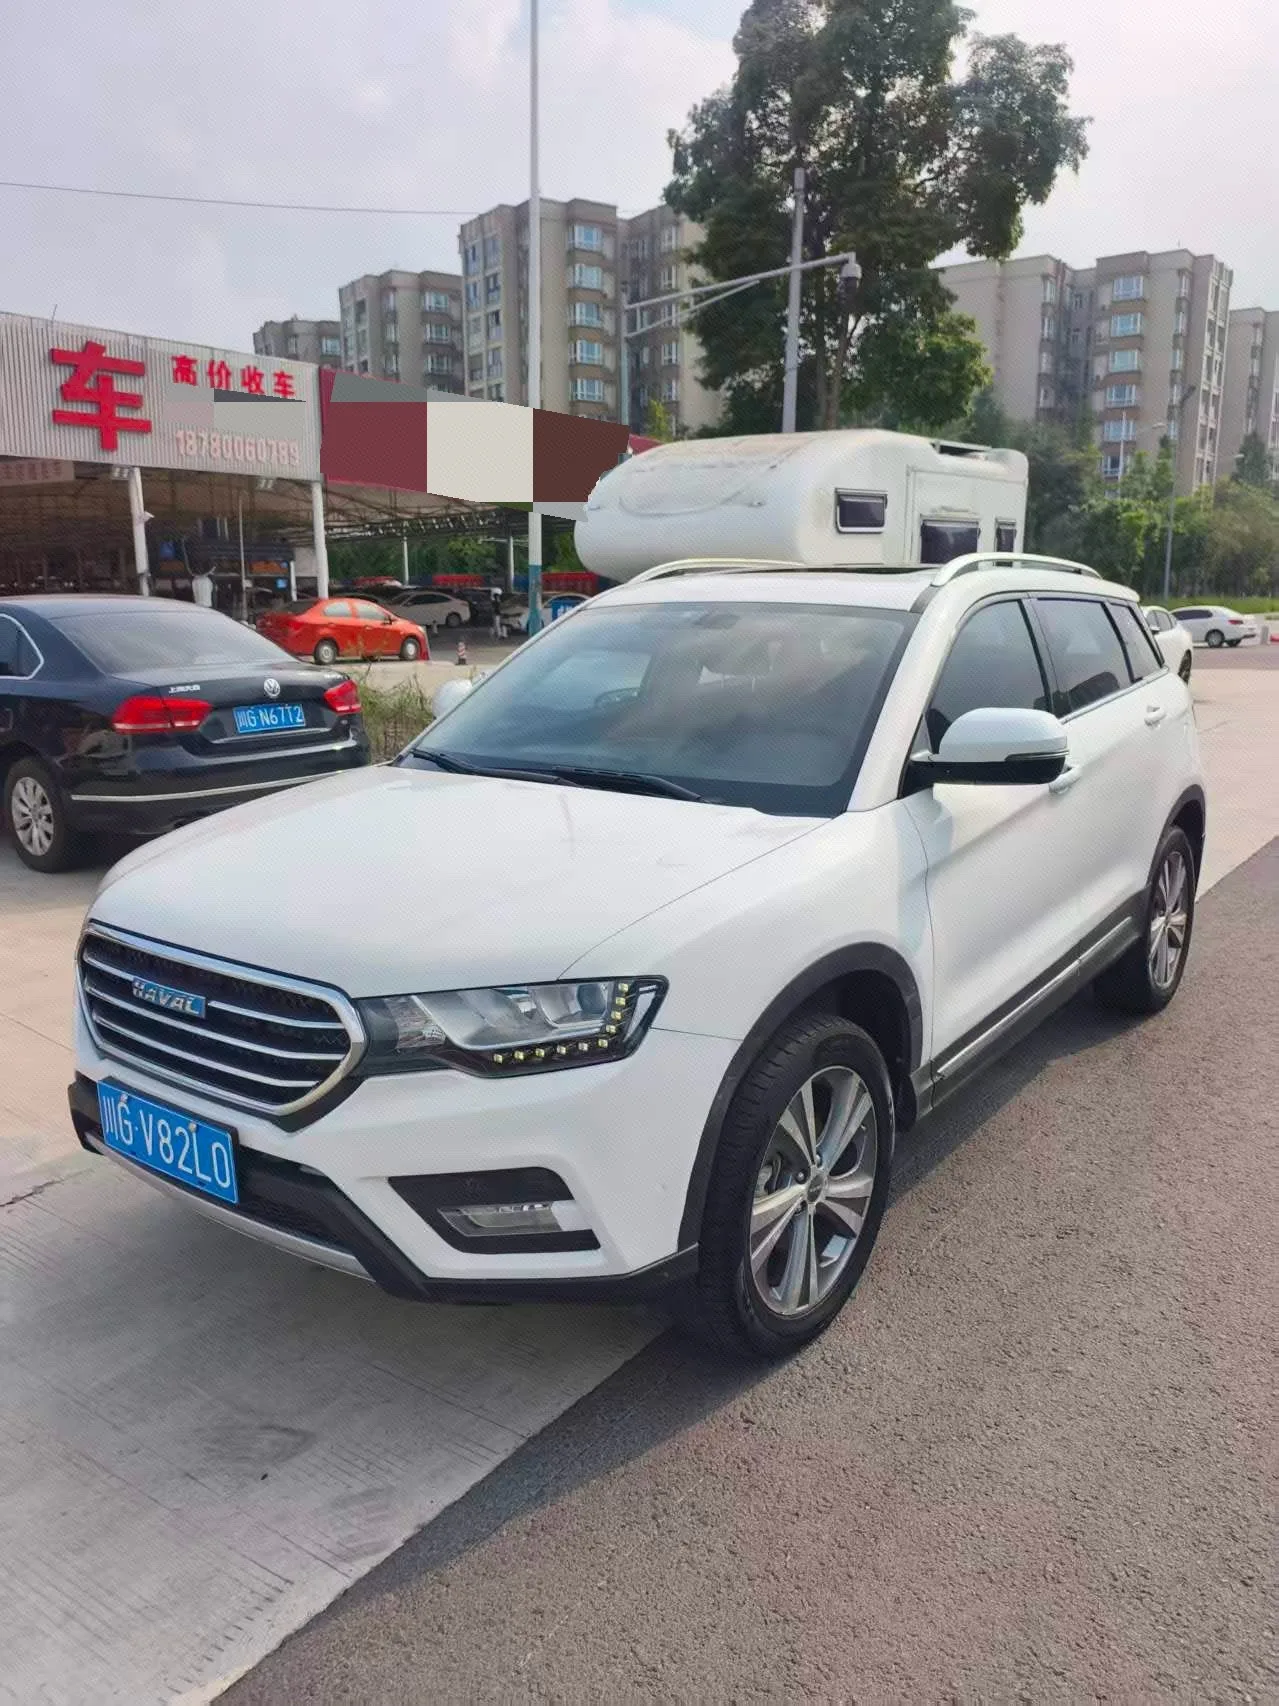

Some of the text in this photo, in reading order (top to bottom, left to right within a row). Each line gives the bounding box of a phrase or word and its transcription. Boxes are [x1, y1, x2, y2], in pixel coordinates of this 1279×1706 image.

[50, 341, 151, 452] 车
[171, 353, 296, 398] 高价收车
[132, 981, 200, 1015] HAVAL
